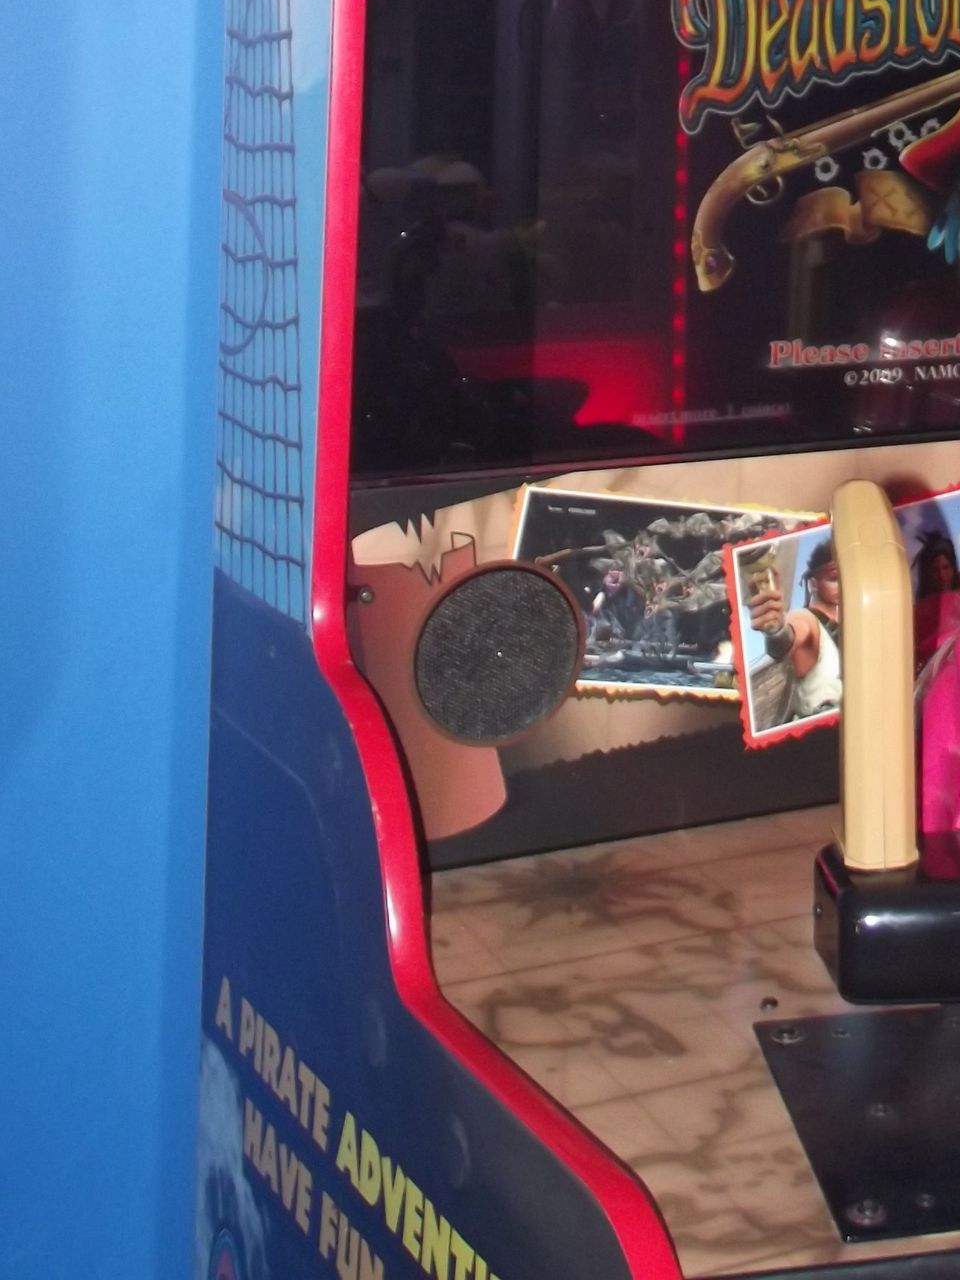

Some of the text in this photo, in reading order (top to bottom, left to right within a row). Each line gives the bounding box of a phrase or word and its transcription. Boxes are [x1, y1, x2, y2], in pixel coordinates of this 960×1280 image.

[768, 338, 870, 368] Please
[215, 976, 233, 1041] A
[239, 996, 331, 1153] PIRATE
[243, 1097, 313, 1237] HAVE
